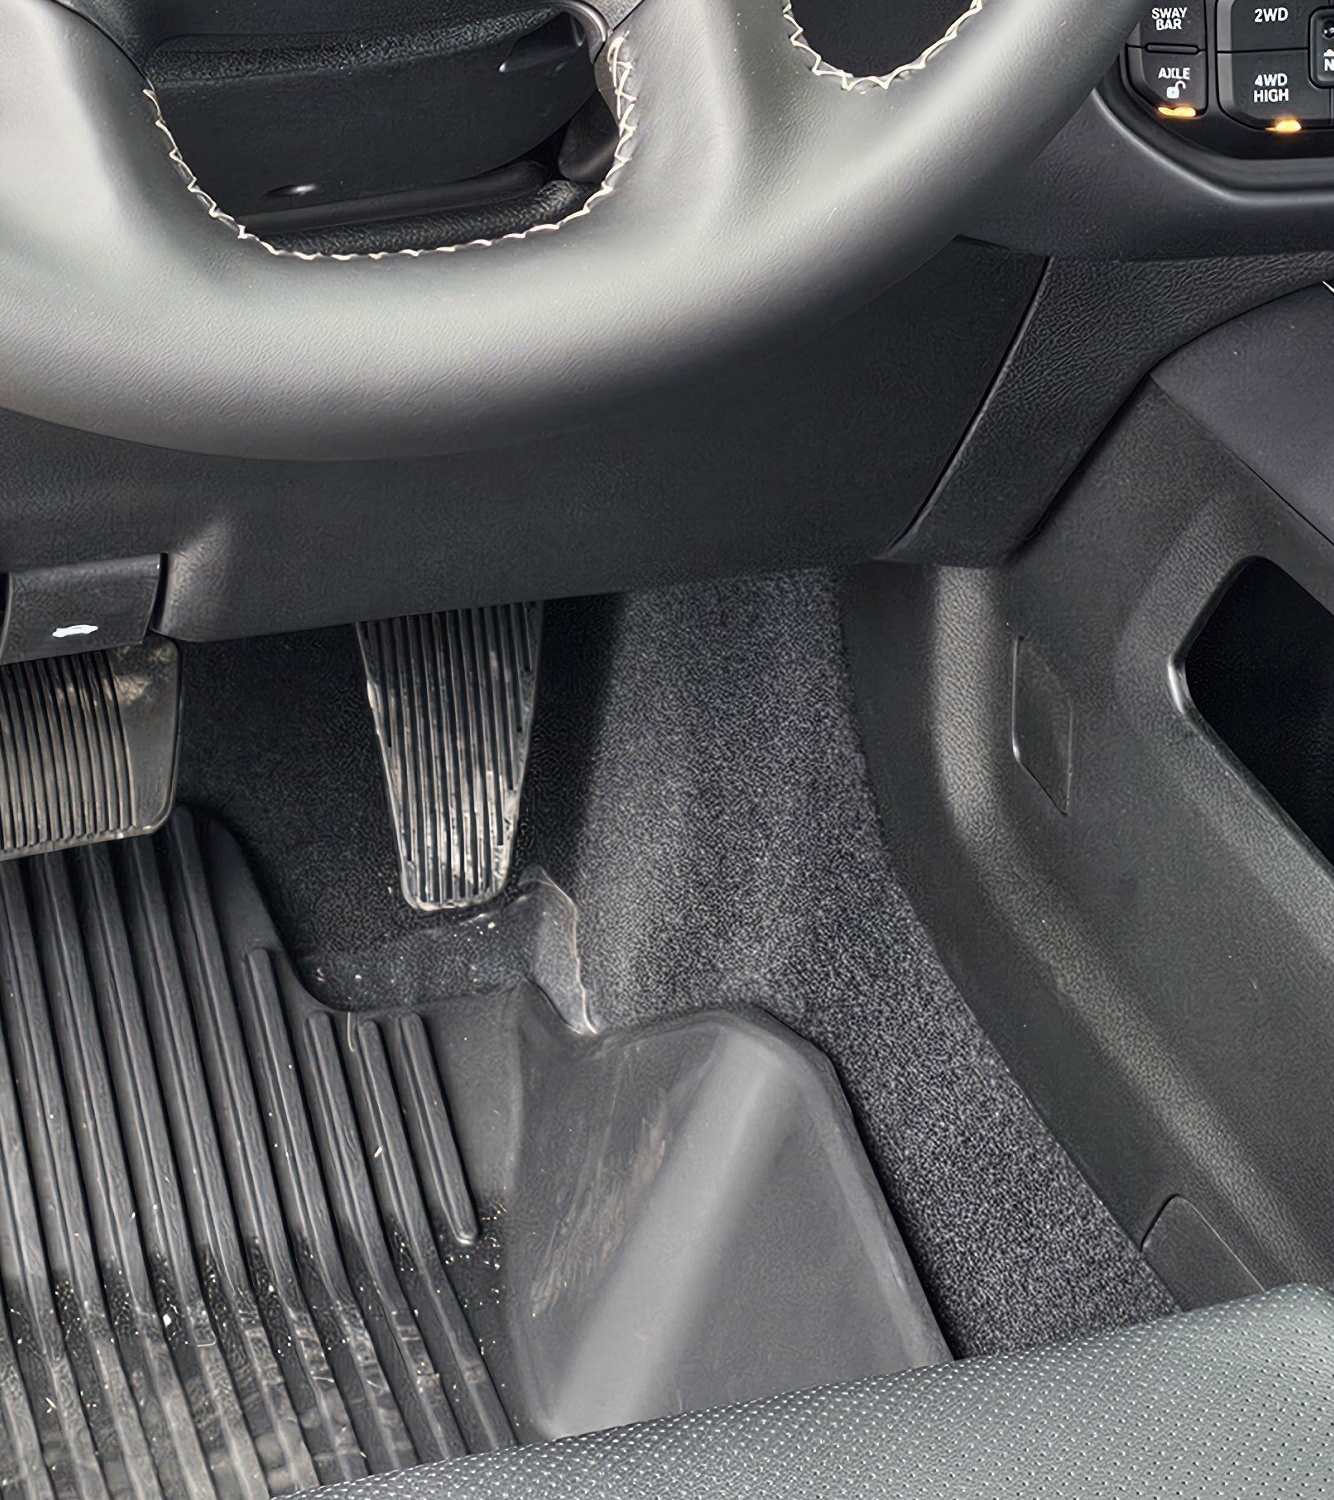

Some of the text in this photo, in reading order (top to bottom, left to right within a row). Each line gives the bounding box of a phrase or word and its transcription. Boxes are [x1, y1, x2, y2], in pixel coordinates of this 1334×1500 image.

[1151, 6, 1188, 20] SWAY
[1253, 6, 1289, 23] 2WD
[1155, 18, 1183, 31] BAR
[1157, 66, 1191, 81] AXLE
[1254, 72, 1289, 88] 4WD
[1253, 87, 1290, 104] HIGH
